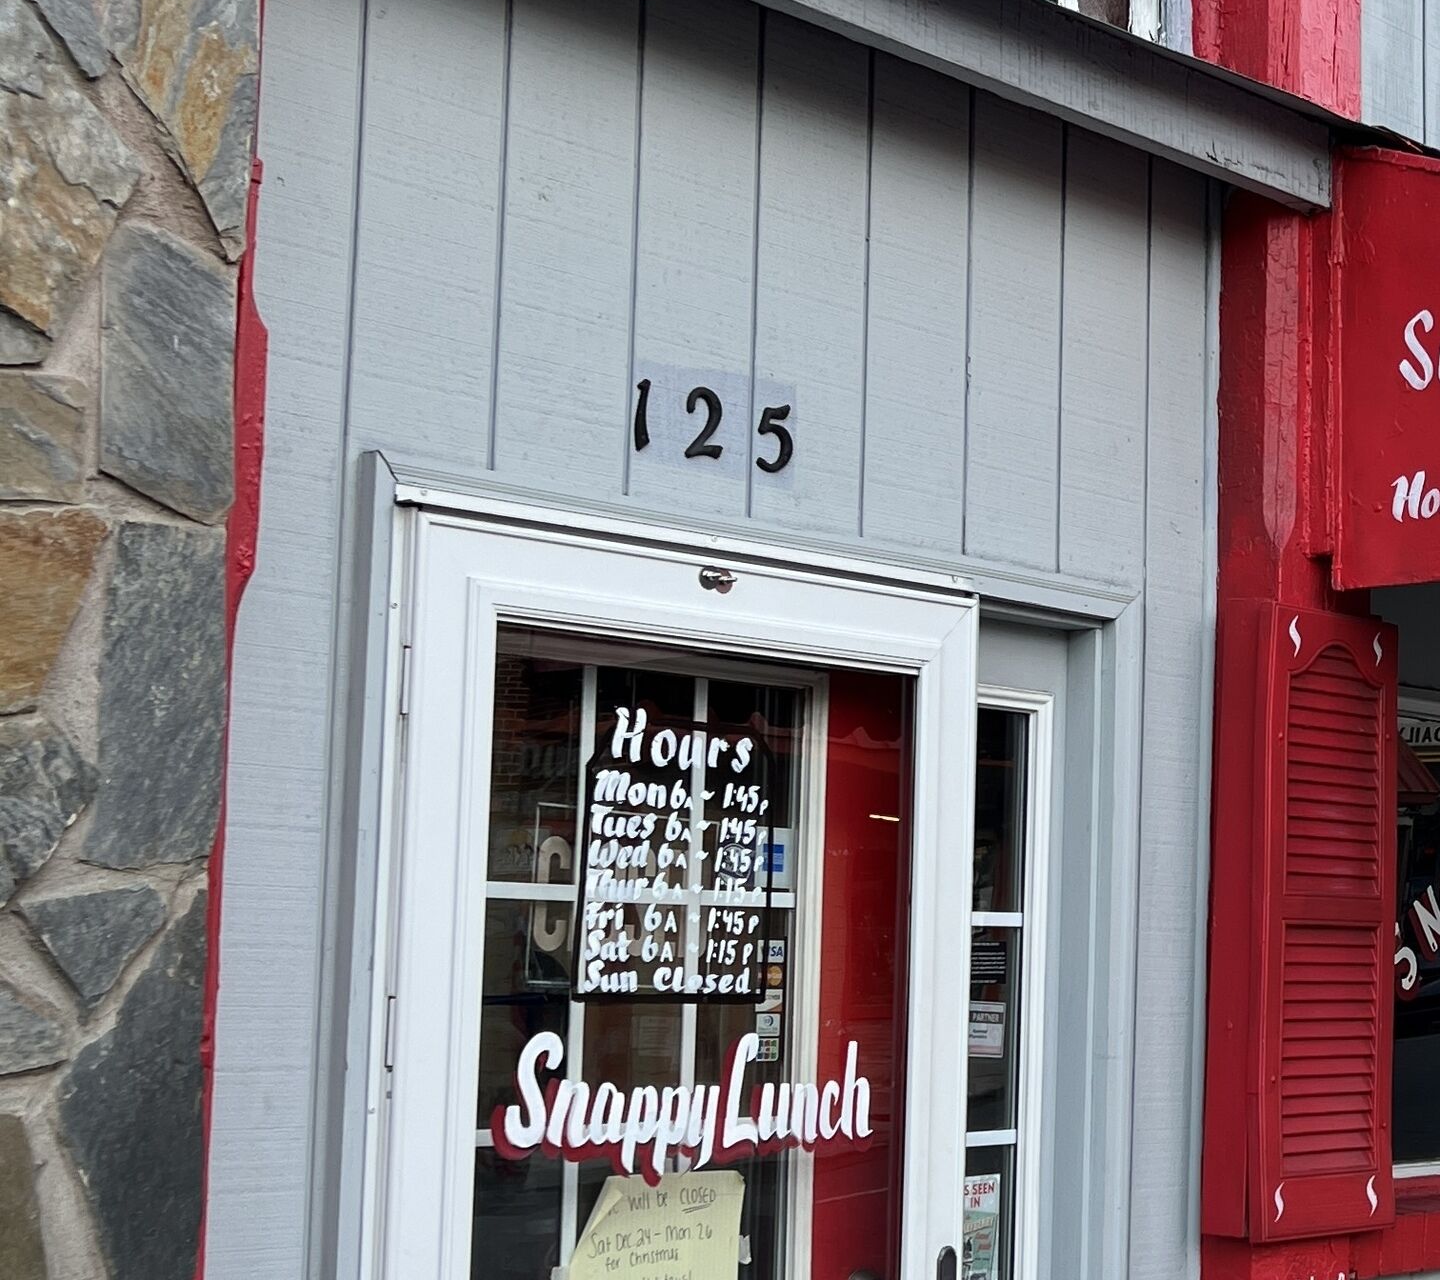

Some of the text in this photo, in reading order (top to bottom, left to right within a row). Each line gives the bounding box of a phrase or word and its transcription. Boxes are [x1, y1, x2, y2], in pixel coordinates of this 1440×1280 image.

[633, 378, 794, 473] 125
[611, 706, 754, 773] Hours
[593, 770, 667, 809] Mon
[590, 803, 658, 839] Tues
[588, 839, 651, 869] Wed
[586, 868, 649, 901] Thur
[585, 900, 625, 931] Fri
[584, 929, 633, 963] Sat
[584, 959, 751, 995] Sun Closed
[502, 1031, 873, 1177] Snappy Lunch
[679, 1186, 717, 1206] CLOSED
[972, 1182, 995, 1195] SEEN
